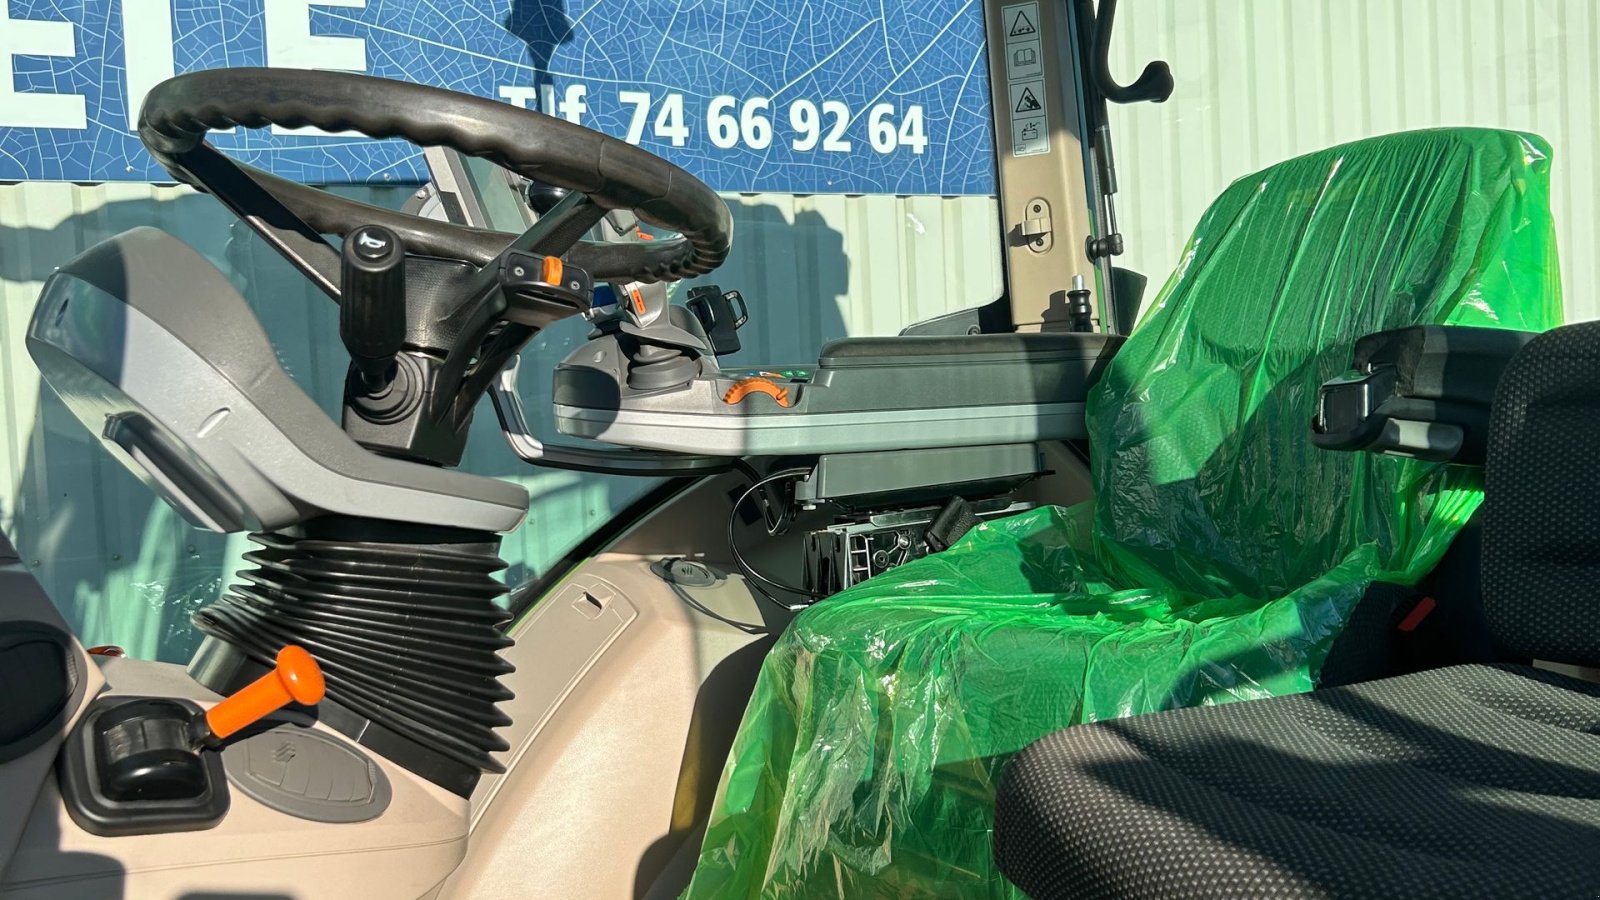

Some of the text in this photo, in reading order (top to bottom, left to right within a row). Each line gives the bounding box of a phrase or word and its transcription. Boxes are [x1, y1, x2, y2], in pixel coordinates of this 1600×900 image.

[619, 92, 689, 147] 74
[707, 95, 773, 150] 66
[789, 99, 851, 152] 92
[868, 103, 927, 155] 64
